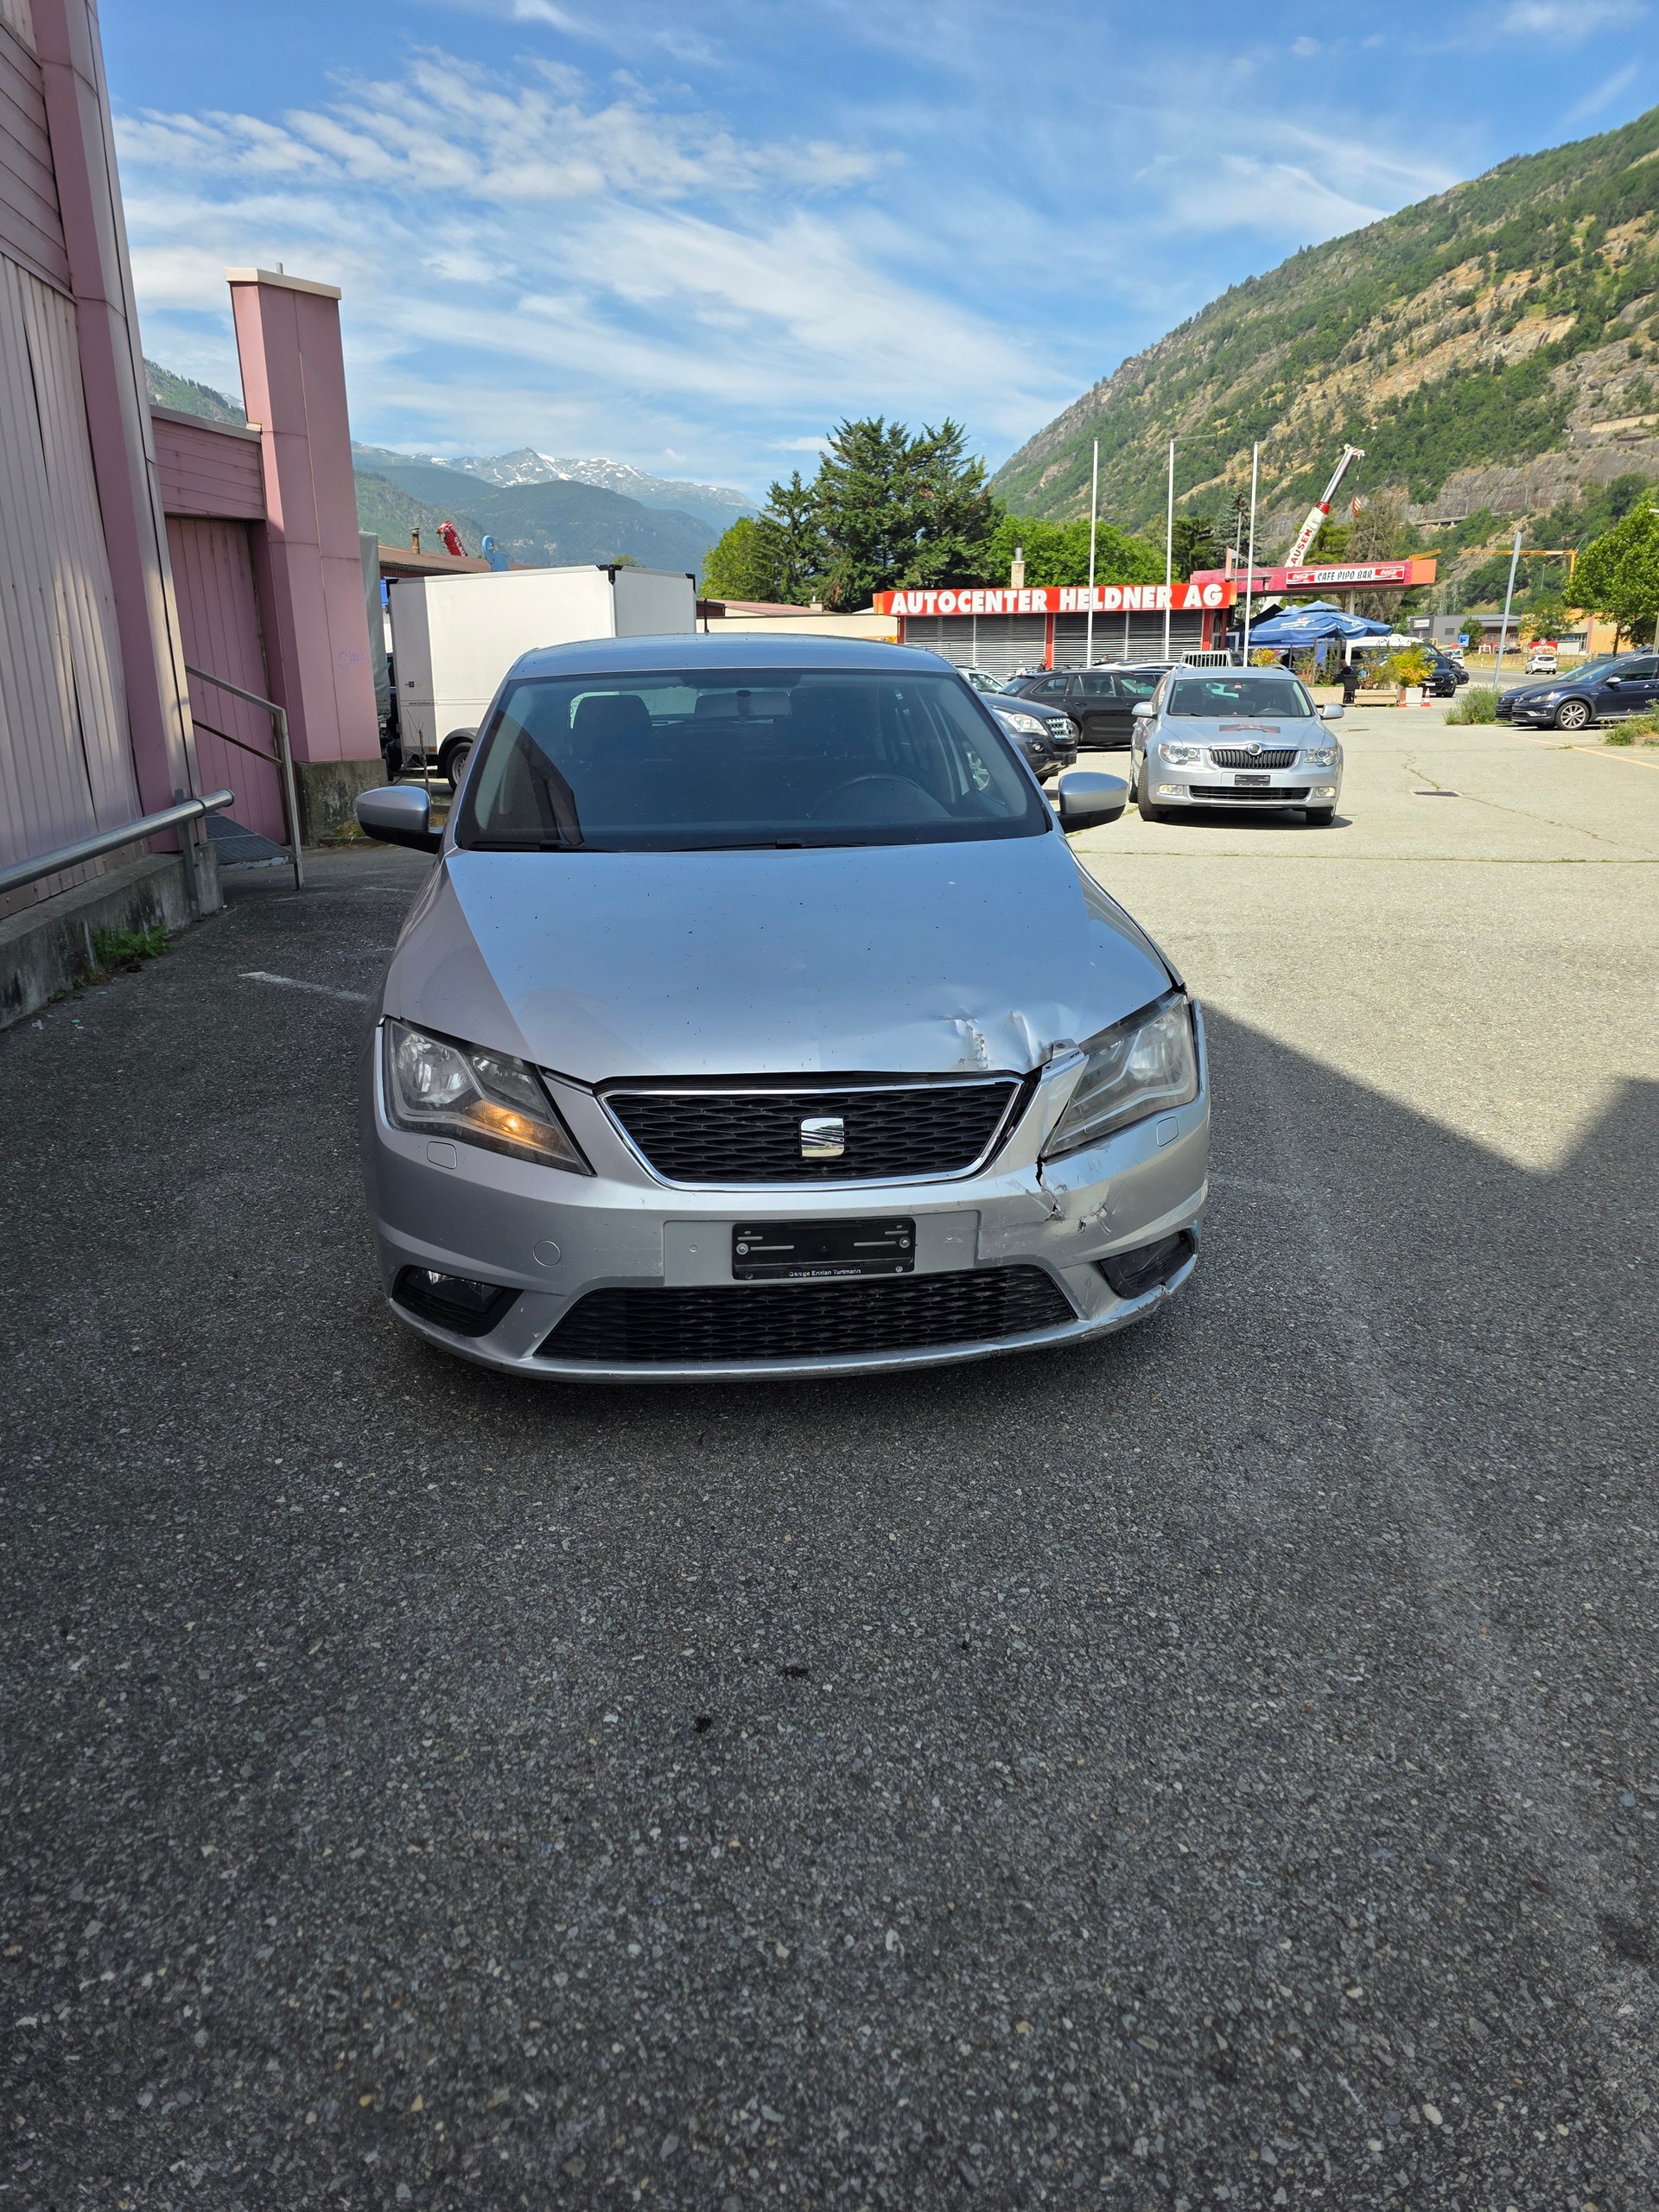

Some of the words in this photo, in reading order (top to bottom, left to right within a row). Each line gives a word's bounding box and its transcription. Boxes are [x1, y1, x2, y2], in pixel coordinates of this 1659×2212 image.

[1290, 529, 1313, 565] AUSEN
[1317, 571, 1335, 582] CAFE
[1337, 570, 1355, 581] PIPO
[1357, 569, 1373, 579] BAR
[890, 589, 1048, 614] AUTOCENTER
[1059, 586, 1173, 611] HELDNER
[1182, 583, 1224, 607] AG
